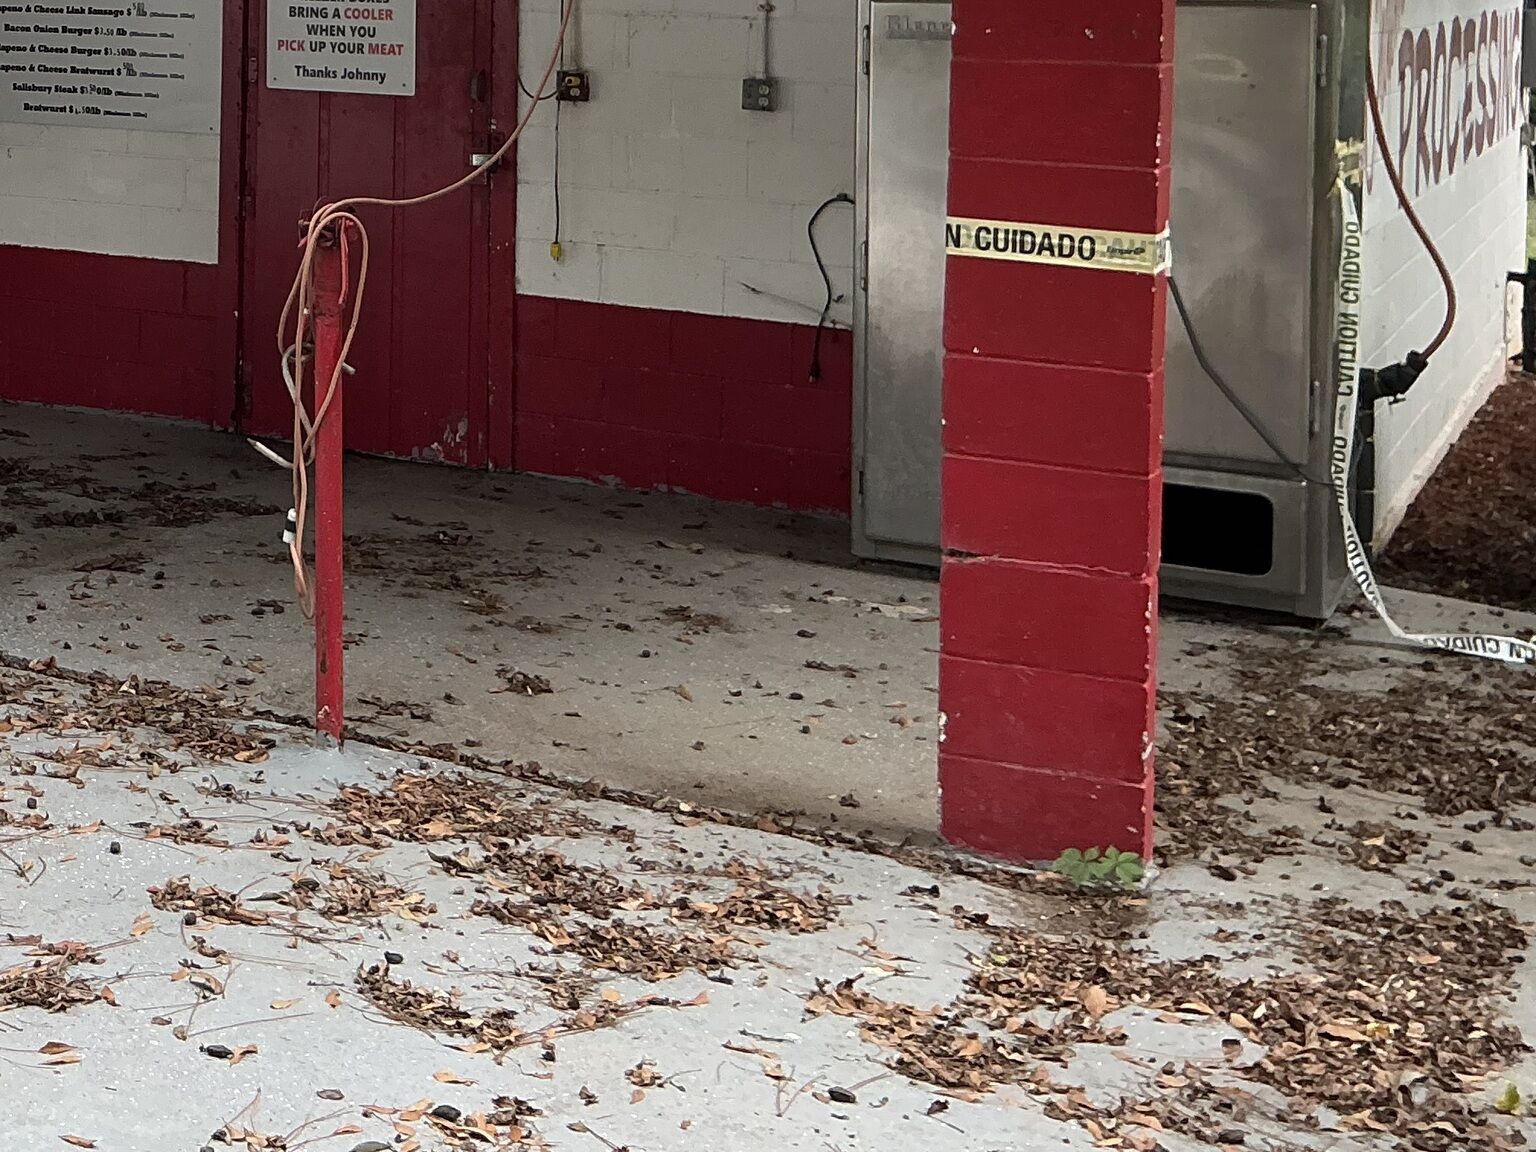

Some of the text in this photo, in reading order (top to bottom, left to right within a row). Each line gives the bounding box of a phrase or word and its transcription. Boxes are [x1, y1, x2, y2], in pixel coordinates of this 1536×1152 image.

[34, 5, 64, 14] Cheese
[66, 6, 85, 14] Link
[88, 7, 124, 18] Sausage
[288, 6, 393, 21] BRING A COOLER
[4, 23, 92, 36] Bacon Onion Burger
[306, 24, 377, 38] WHEN YOU
[38, 44, 68, 54] Cheese
[70, 46, 102, 57] Burger
[277, 39, 404, 56] PICK UP YOUR MEAT
[37, 64, 68, 73] Cheese
[70, 65, 114, 76] Bratwurst
[294, 65, 386, 85] Thanks Johnny
[12, 83, 52, 95] Salisbury
[54, 84, 78, 94] Steak
[23, 102, 66, 113] Bratwurst
[1397, 6, 1521, 209] PROCESSING
[973, 225, 1096, 261] CUIDADO
